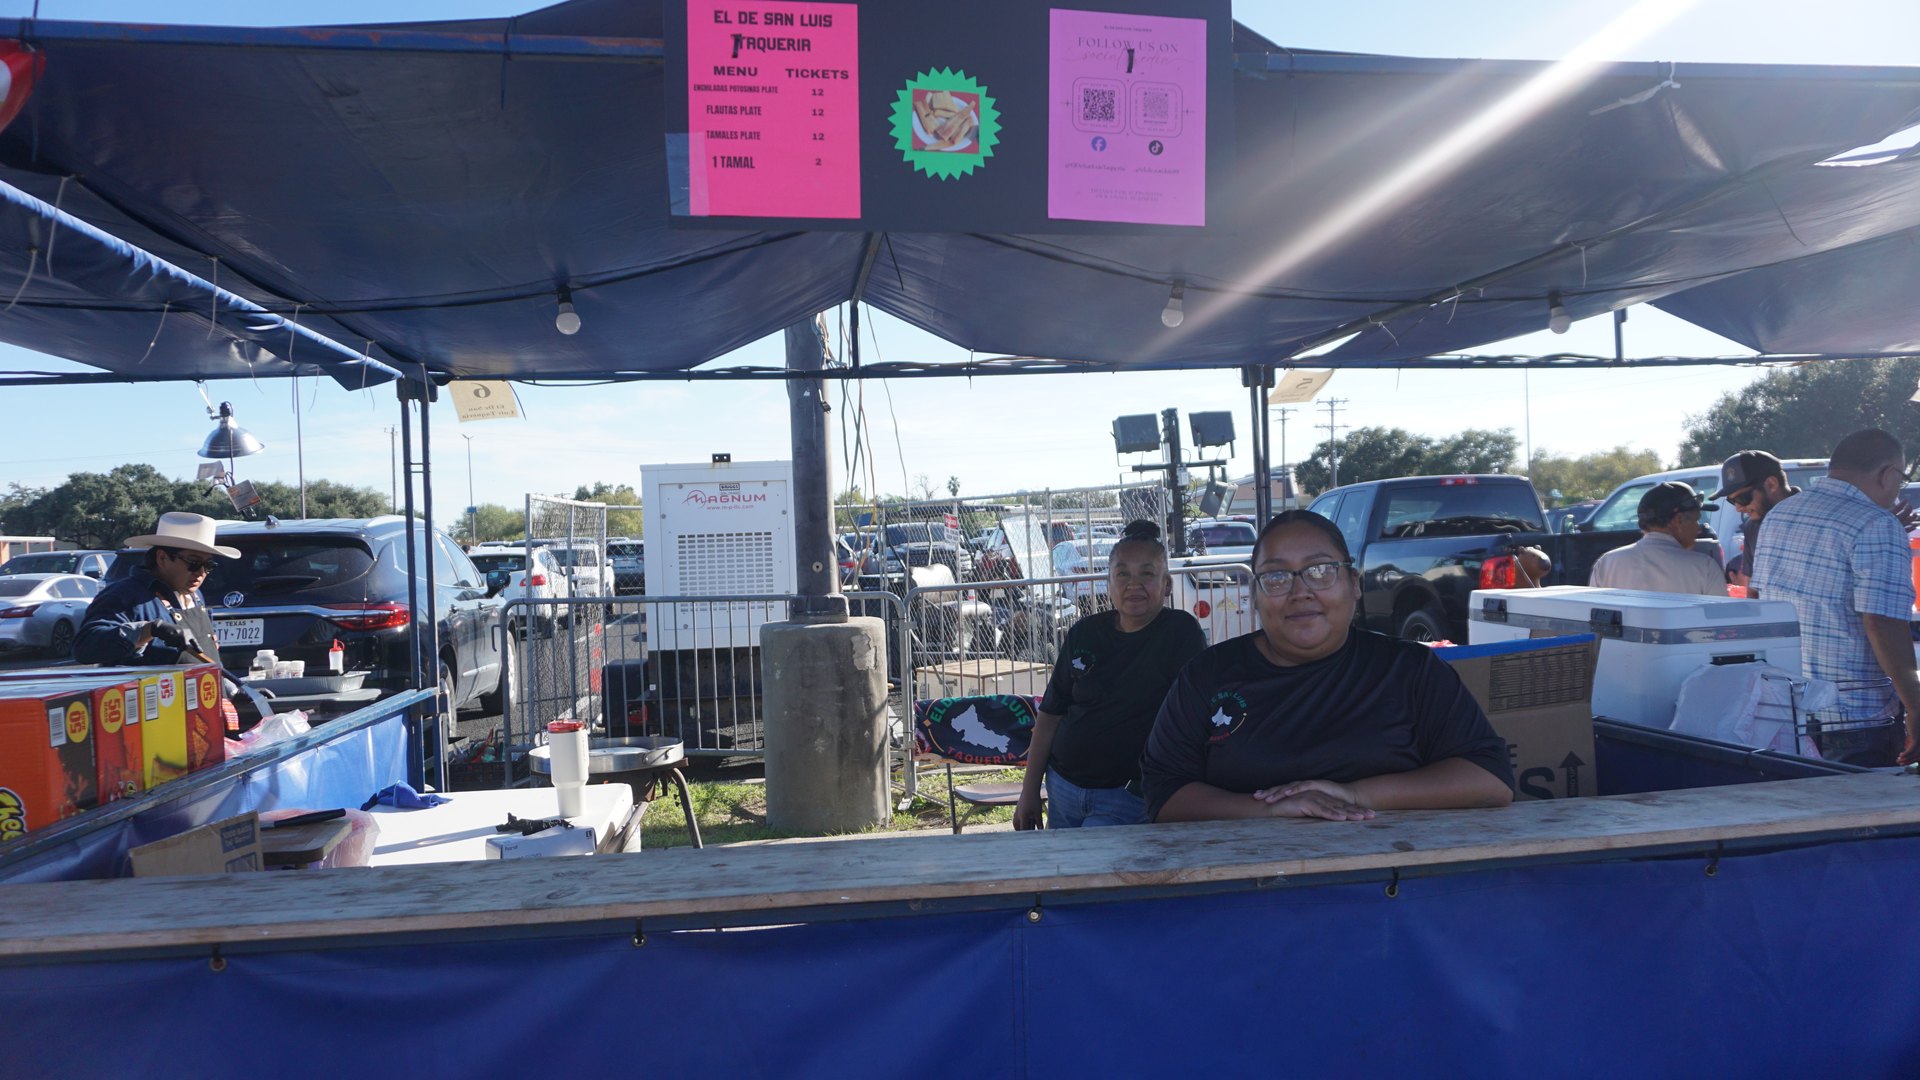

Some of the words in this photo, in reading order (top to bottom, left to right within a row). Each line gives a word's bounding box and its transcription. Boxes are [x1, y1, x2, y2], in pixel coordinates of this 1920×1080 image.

[714, 10, 732, 24] EL
[738, 11, 758, 25] DE
[764, 12, 794, 26] SAN
[800, 14, 833, 28] LUIS
[1078, 36, 1134, 50] FOLLOW
[1139, 41, 1156, 52] US
[1160, 43, 1178, 53] ON
[713, 66, 758, 77] MENU
[785, 68, 849, 79] TICKETS
[761, 86, 778, 94] PLATE
[811, 88, 824, 96] 12
[706, 105, 738, 115] FLAUTAS
[740, 106, 762, 116] PLATE
[706, 130, 738, 140] TAMALES
[740, 131, 761, 140] PLATE
[712, 156, 717, 168] 1
[720, 156, 755, 169] TAMAL
[815, 158, 822, 166] 2
[160, 678, 170, 699] 50
[203, 681, 211, 700] 50
[109, 698, 121, 723] 50
[1001, 695, 1031, 725] LUIS
[69, 710, 82, 734] 50
[948, 747, 1016, 764] TAQUERIA
